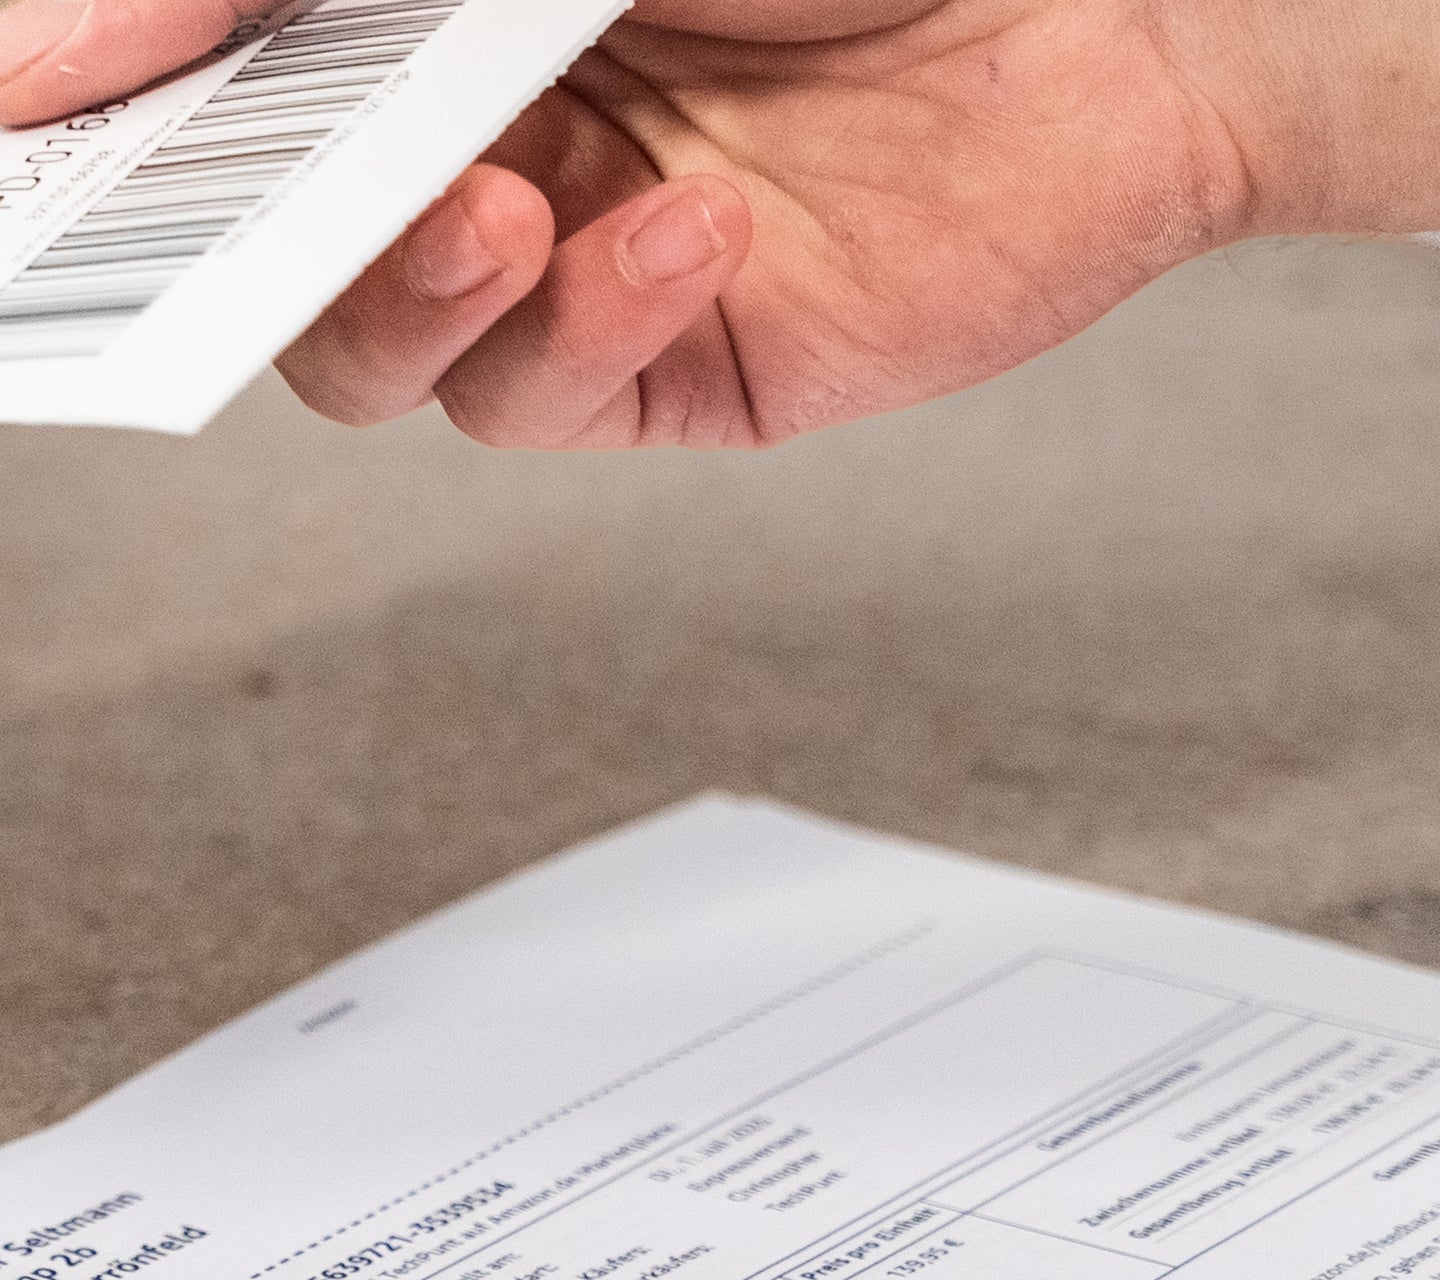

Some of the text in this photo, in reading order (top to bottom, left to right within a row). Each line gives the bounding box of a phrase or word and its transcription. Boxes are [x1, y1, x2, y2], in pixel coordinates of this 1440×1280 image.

[1, 1192, 141, 1256] Seltmann
[49, 1246, 98, 1267] 2b
[377, 1238, 463, 1278] TechPunt
[460, 1221, 489, 1240] auf
[576, 1246, 648, 1280] Käufers:
[799, 1257, 850, 1280] Preis
[845, 1241, 880, 1260] pro
